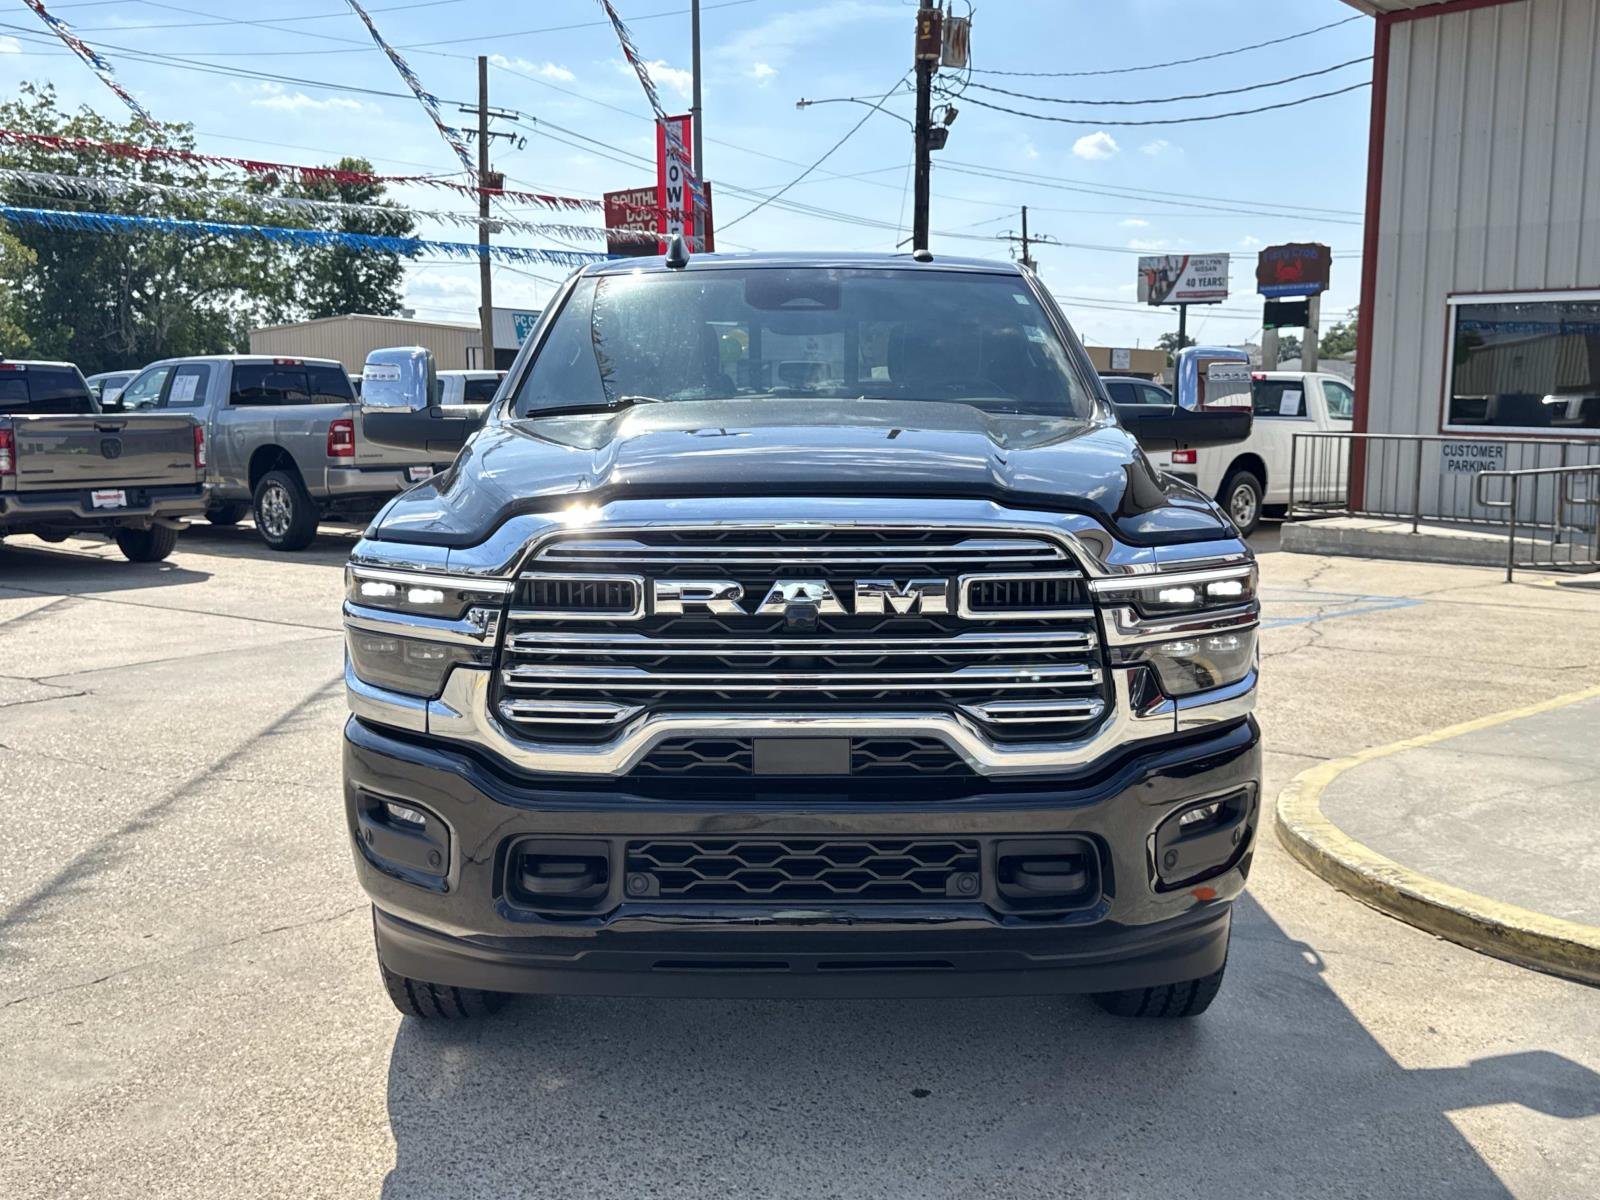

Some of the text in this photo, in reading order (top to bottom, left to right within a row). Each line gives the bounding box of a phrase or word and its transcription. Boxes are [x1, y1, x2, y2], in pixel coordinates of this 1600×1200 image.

[1186, 278, 1196, 288] 40
[1443, 444, 1503, 458] CUSTOMER
[1448, 459, 1496, 472] PARKING
[653, 579, 949, 615] RAM
